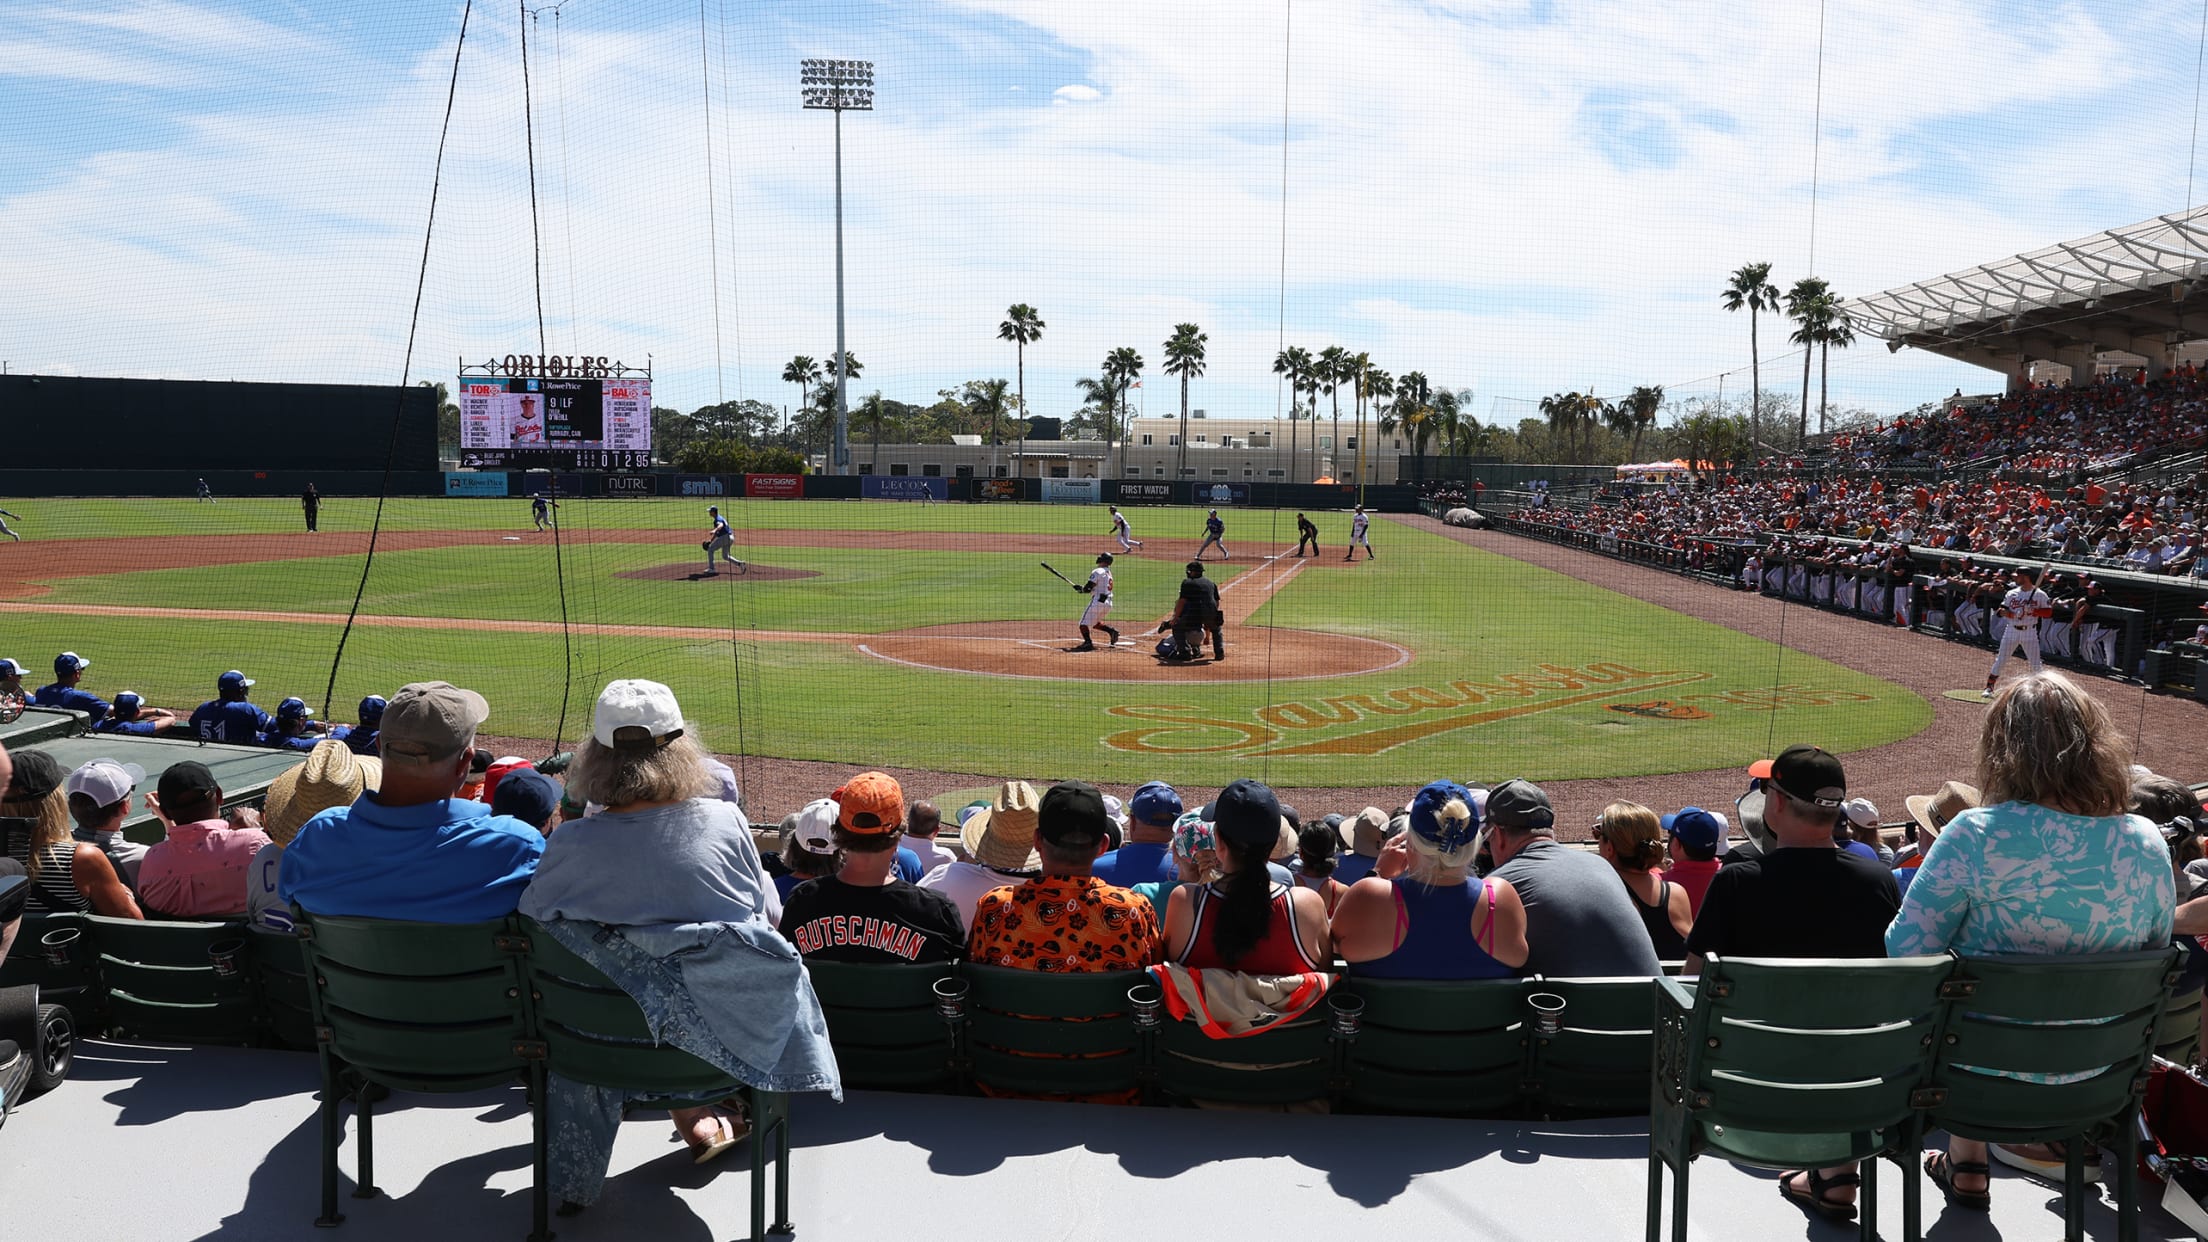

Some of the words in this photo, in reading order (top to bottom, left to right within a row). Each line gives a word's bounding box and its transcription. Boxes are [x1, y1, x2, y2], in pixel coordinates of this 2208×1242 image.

[504, 354, 608, 378] ORIOLES
[470, 385, 490, 394] TOR
[612, 388, 628, 398] BAL
[550, 397, 556, 408] 9
[563, 397, 573, 408] LF
[602, 454, 608, 467] 0
[614, 454, 618, 467] 1
[625, 454, 631, 467] 2
[636, 454, 649, 467] 95
[682, 476, 723, 495] smh
[752, 478, 797, 486] FASTSIGNS
[1120, 484, 1142, 494] FIRST
[1143, 485, 1169, 495] WATCH
[1104, 662, 1714, 756] Sarasota
[795, 915, 927, 960] RUTSCHMAN
